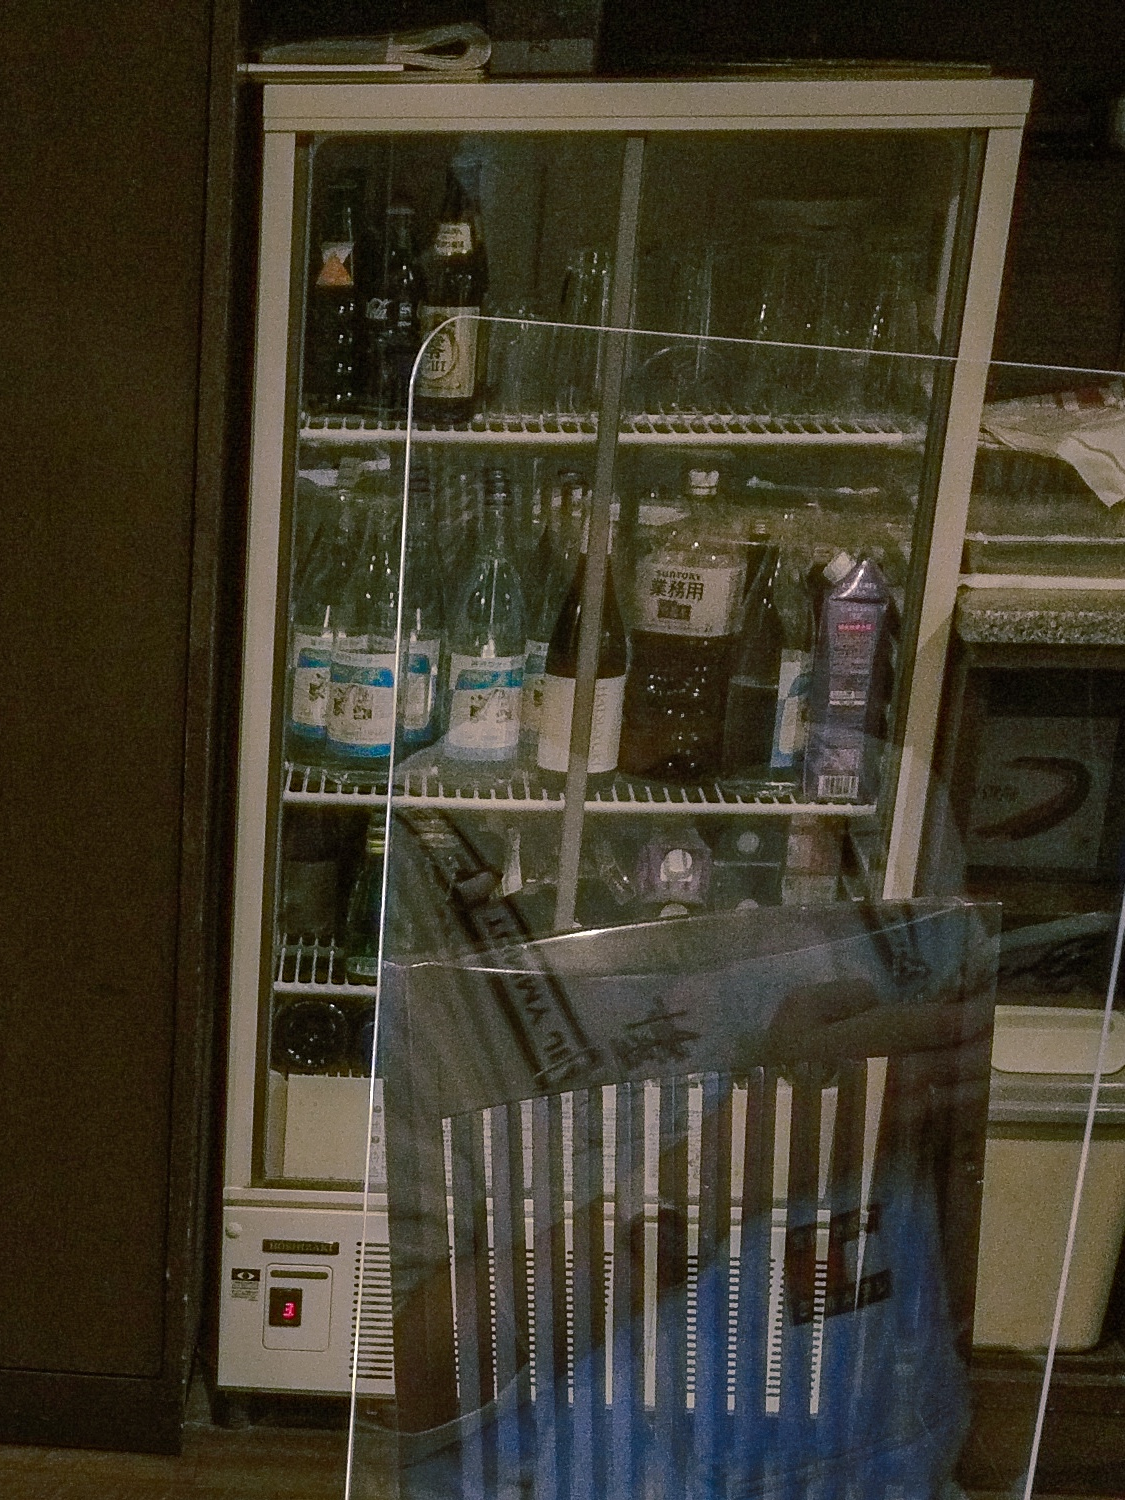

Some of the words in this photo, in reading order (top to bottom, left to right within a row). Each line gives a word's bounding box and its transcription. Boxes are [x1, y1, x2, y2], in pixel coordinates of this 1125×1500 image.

[650, 578, 704, 601] 業務用
[283, 1302, 296, 1319] 3
